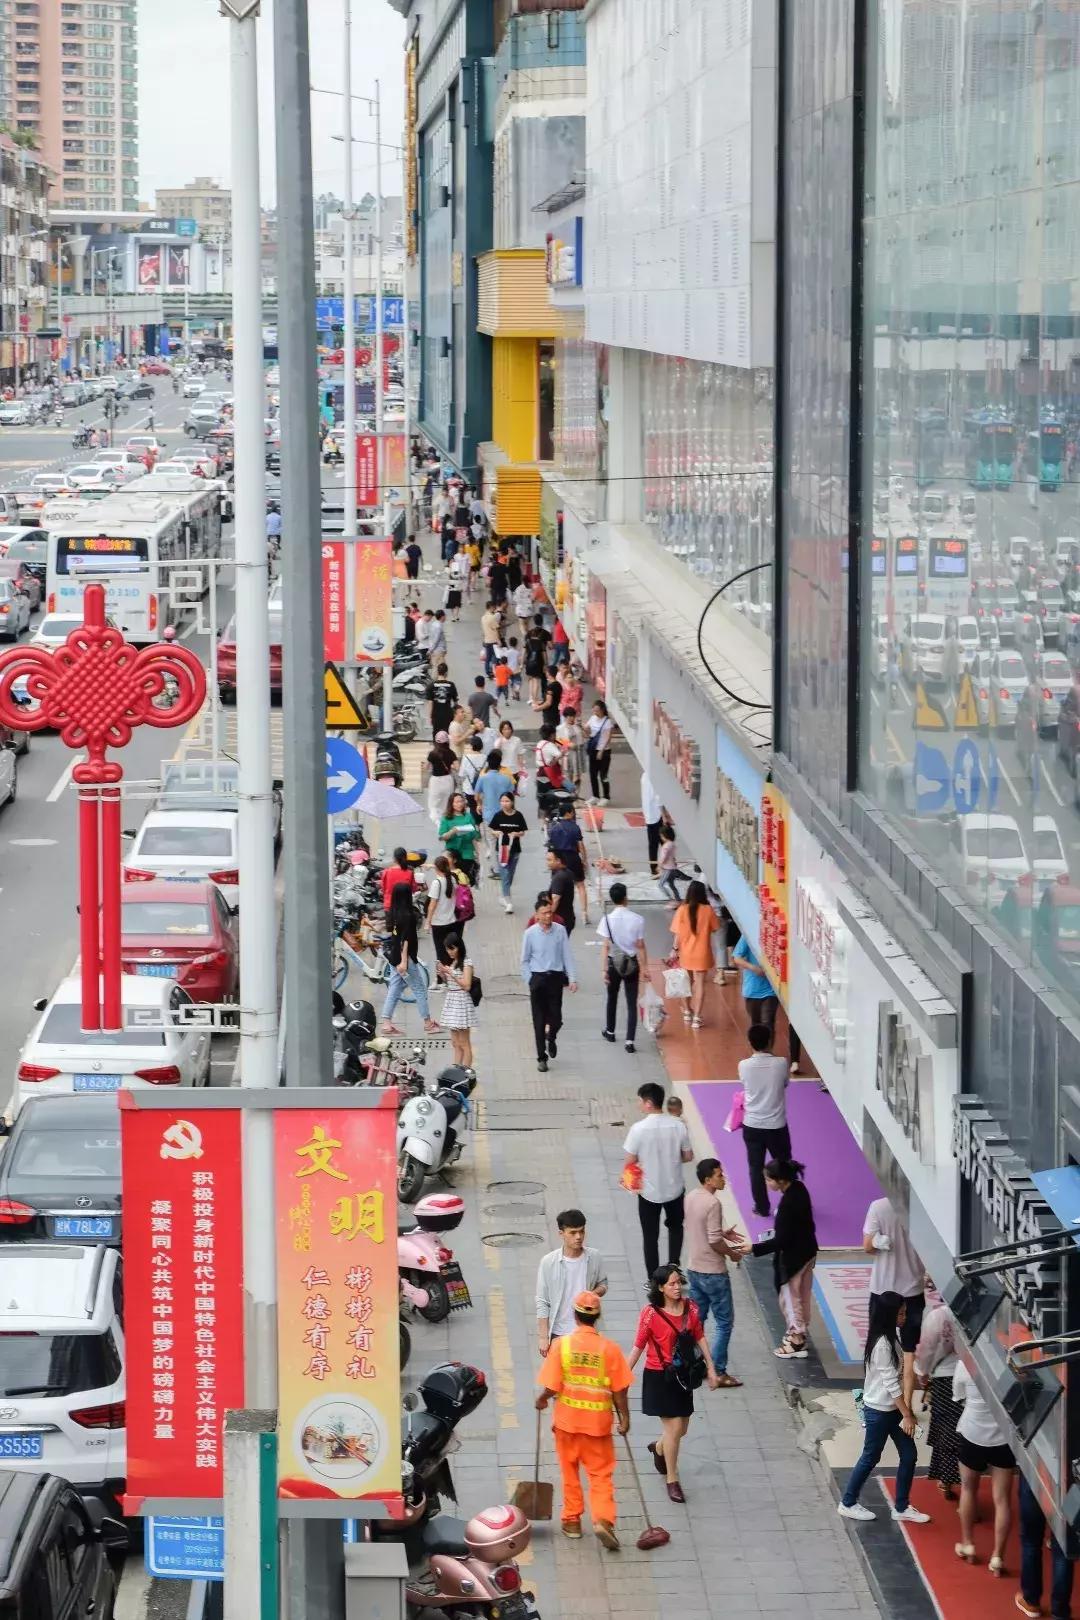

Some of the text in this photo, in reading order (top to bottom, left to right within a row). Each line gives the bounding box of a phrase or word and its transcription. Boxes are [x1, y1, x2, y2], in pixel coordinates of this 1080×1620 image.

[294, 1125, 385, 1244] 文明
[151, 1199, 176, 1440] 凝聚同心共筑中国梦的磅礴力量
[192, 1170, 218, 1468] 积极投身新时代中国特色社会主义伟大实践
[302, 1265, 331, 1380] 仁德有序
[345, 1265, 377, 1380] 彬彬有礼
